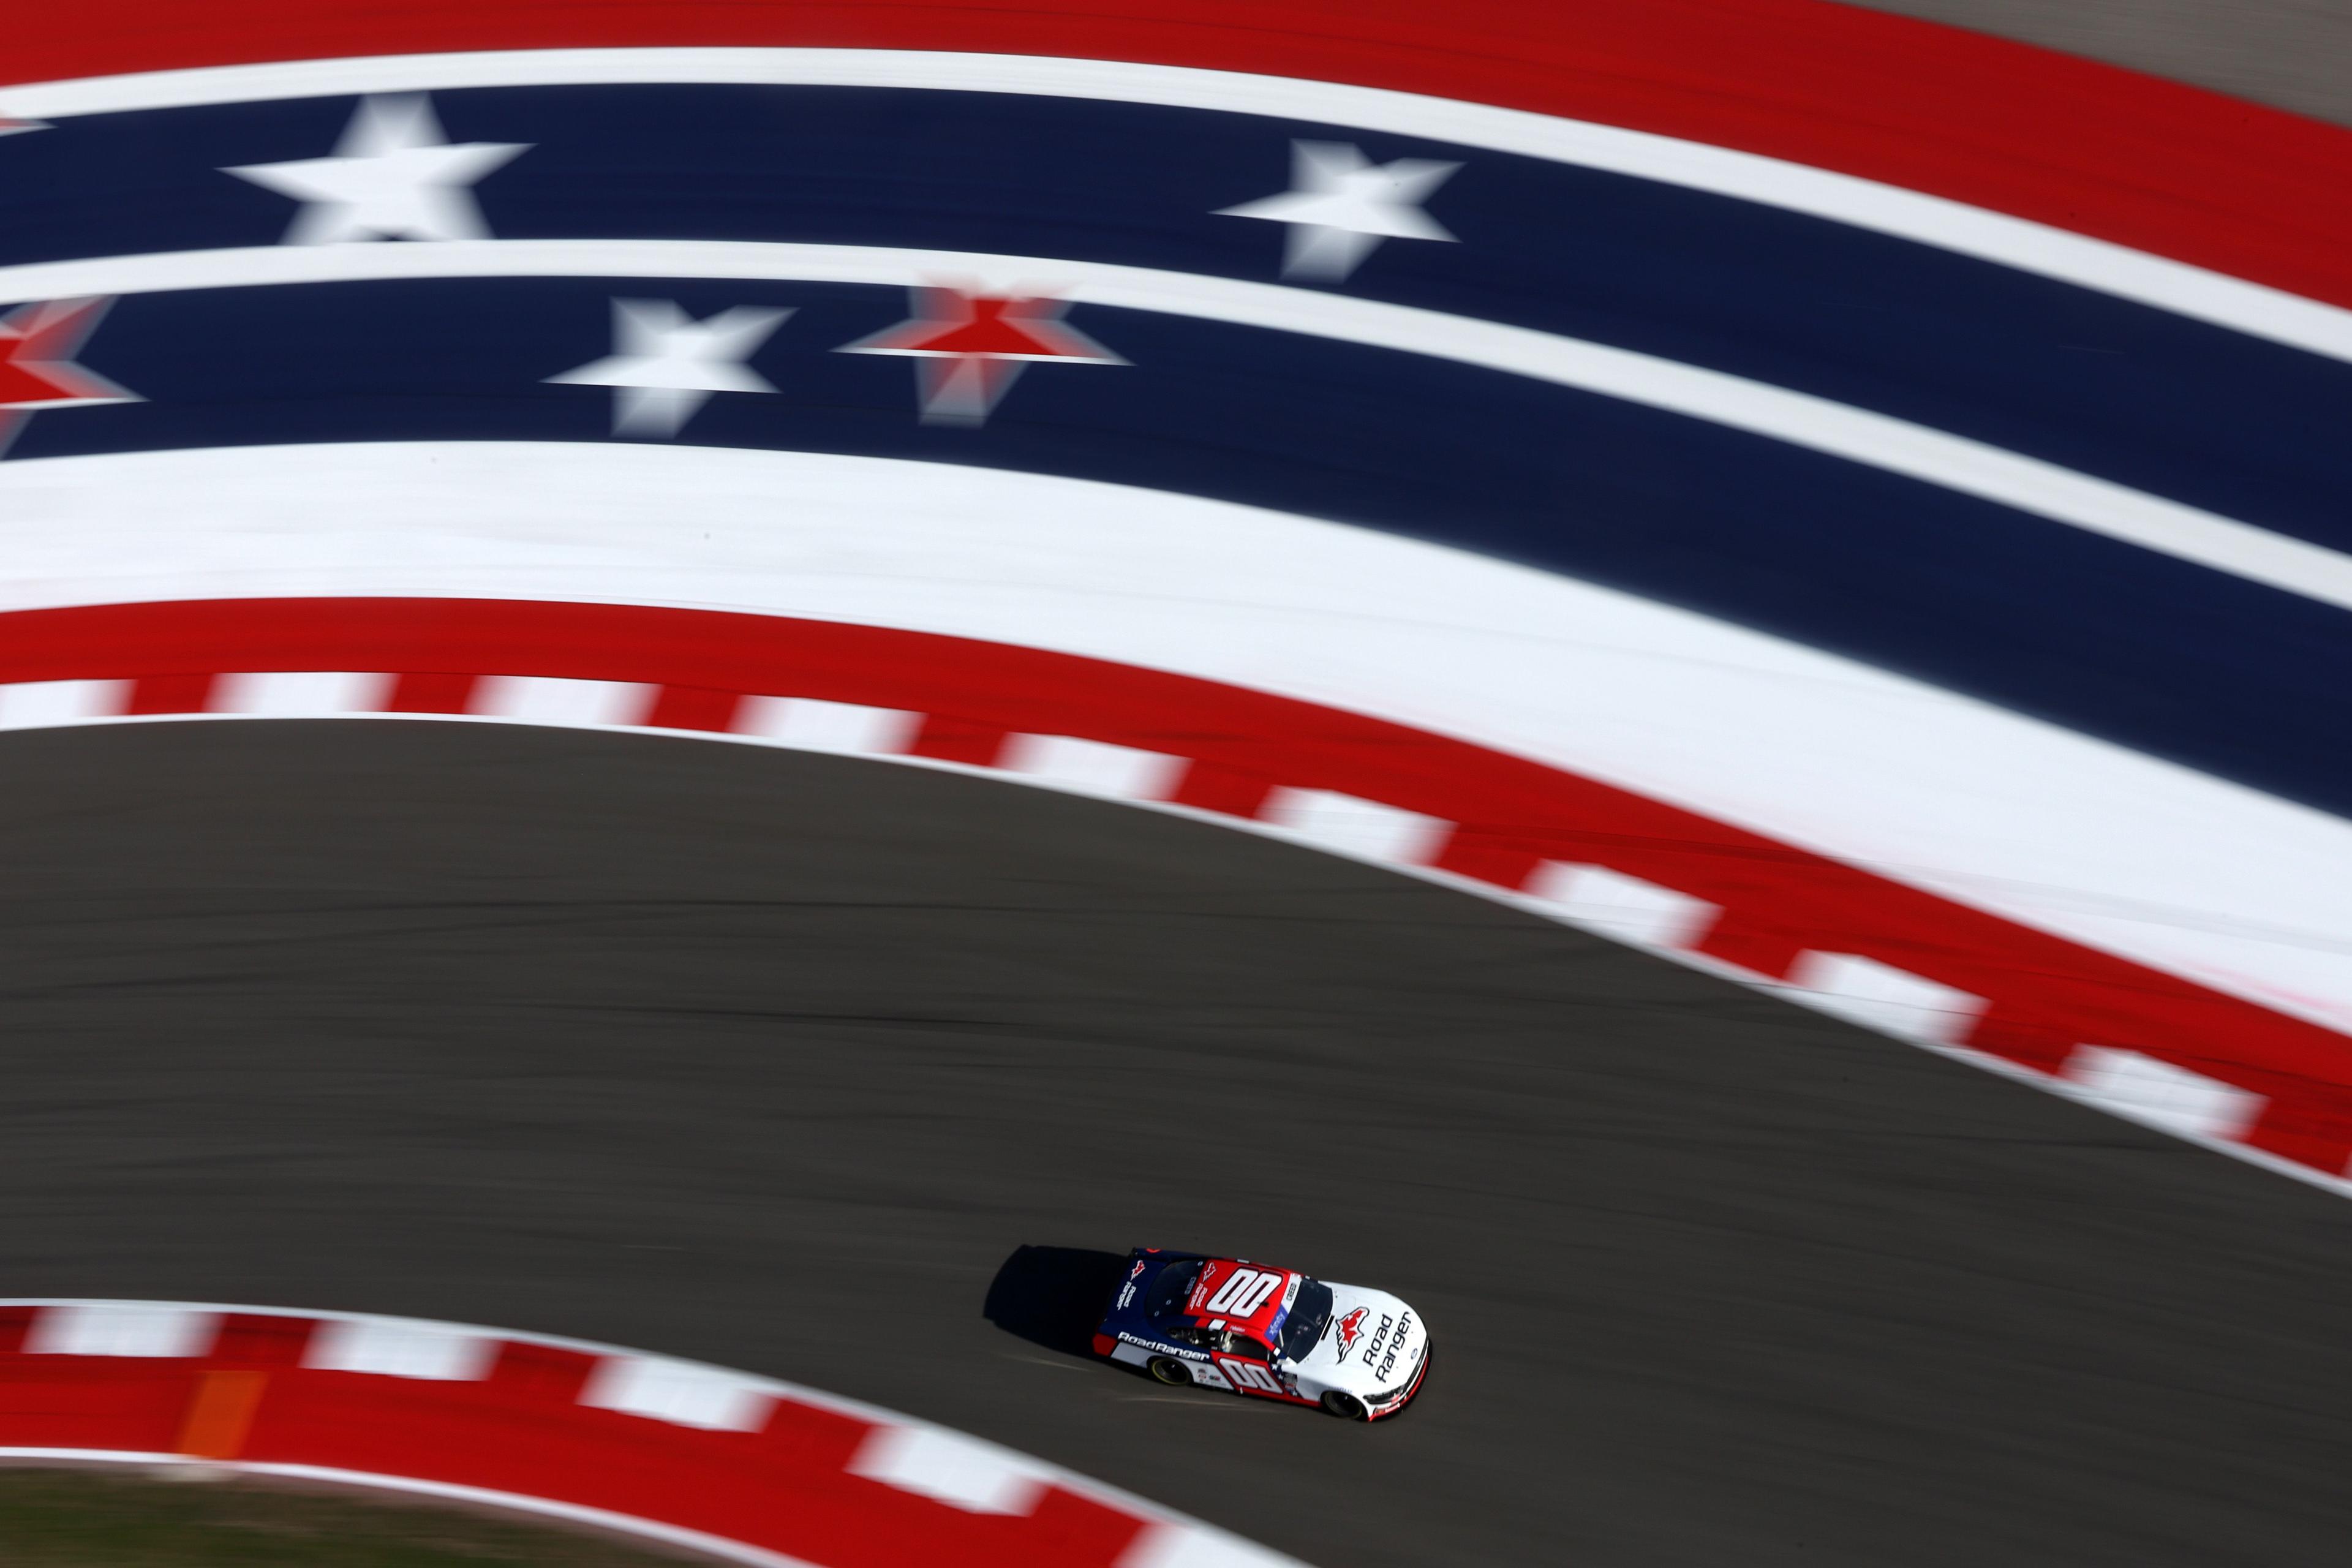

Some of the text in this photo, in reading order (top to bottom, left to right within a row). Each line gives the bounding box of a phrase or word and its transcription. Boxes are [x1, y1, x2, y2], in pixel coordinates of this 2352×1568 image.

[1206, 1267, 1283, 1318] 00
[1117, 1331, 1210, 1361] Road Ranger
[1362, 1313, 1393, 1367] Road
[1375, 1311, 1412, 1383] Ranger
[1219, 1357, 1283, 1394] 00
